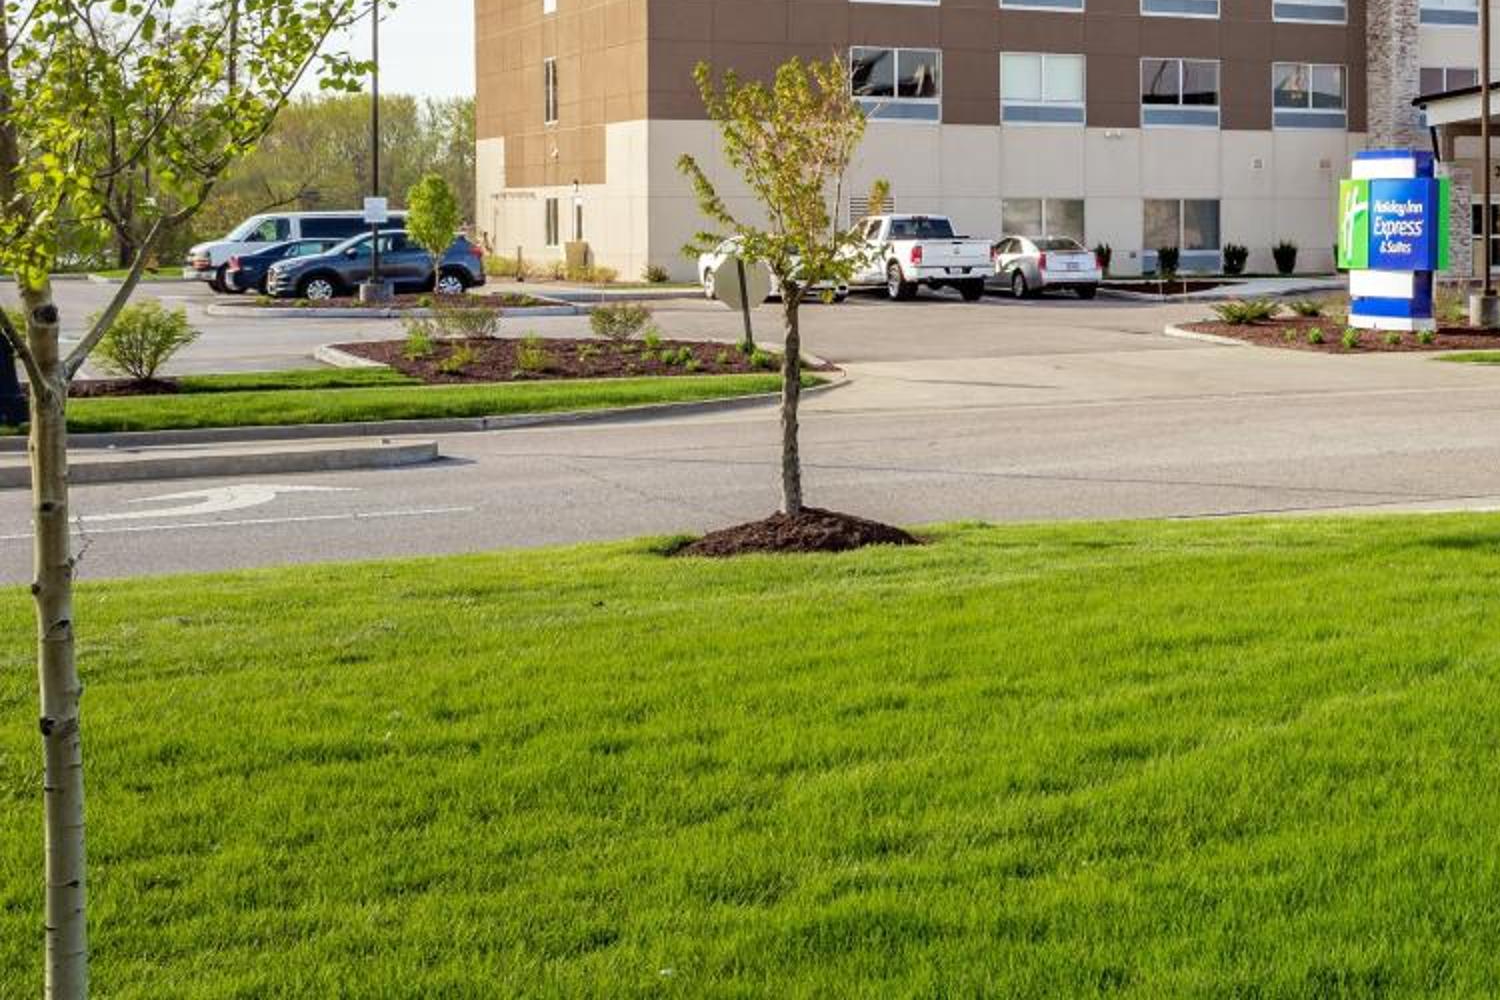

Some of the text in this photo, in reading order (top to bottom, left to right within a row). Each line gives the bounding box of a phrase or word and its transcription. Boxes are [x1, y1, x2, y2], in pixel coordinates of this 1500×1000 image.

[1374, 199, 1424, 217] Holiday Inn
[1373, 215, 1425, 241] Express
[1388, 240, 1412, 254] Suites
